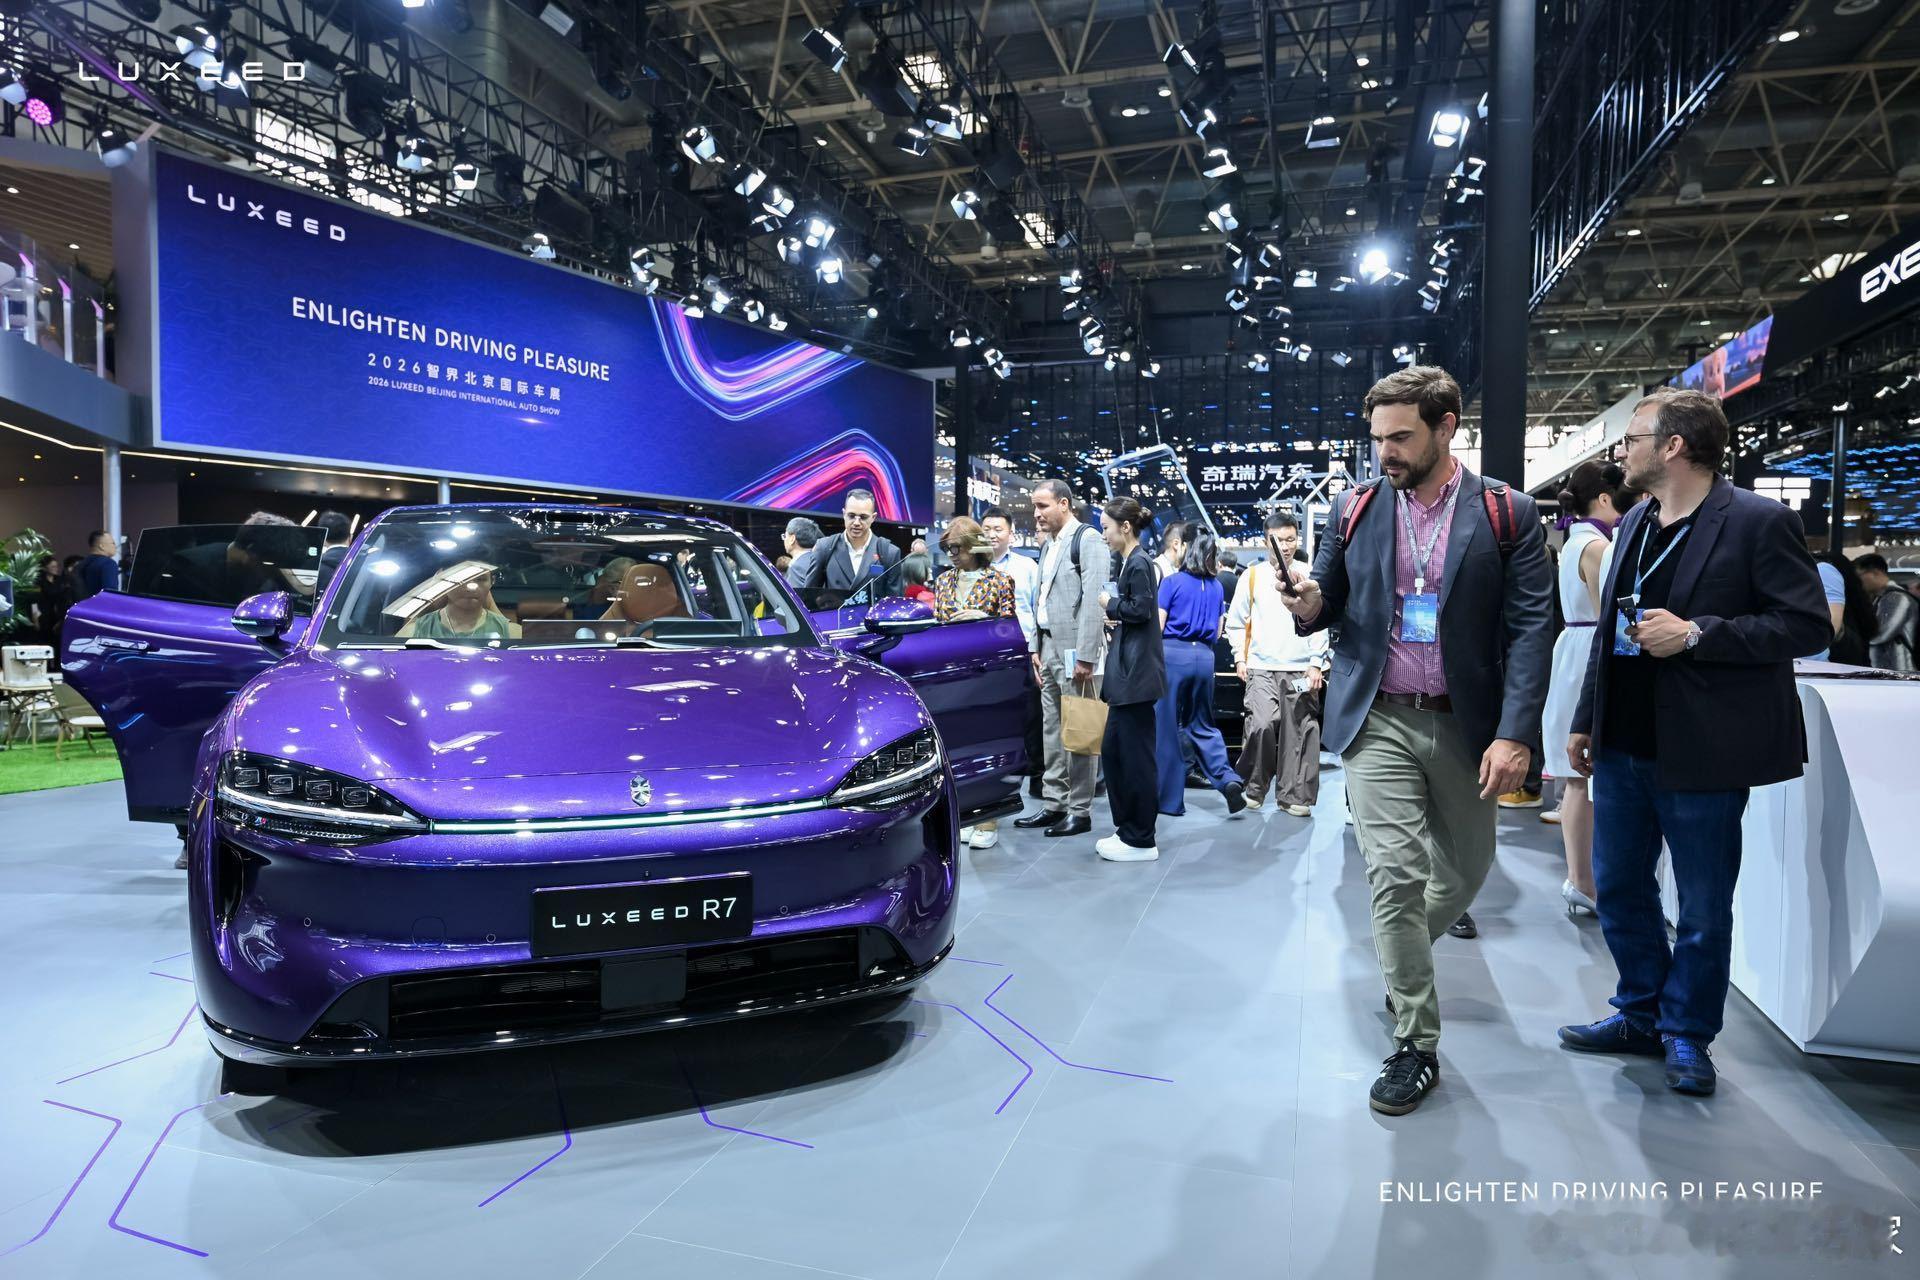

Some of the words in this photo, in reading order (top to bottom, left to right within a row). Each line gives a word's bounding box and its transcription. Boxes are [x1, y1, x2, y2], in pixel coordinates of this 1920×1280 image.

[187, 184, 346, 242] LUXEED
[292, 296, 426, 343] ENLIGHTEN
[435, 328, 517, 362] DRIVING
[523, 347, 610, 381] PLEASURE
[368, 376, 390, 388] 2026
[391, 380, 425, 393] LUXEED
[426, 385, 457, 399] BEIJING
[458, 391, 517, 409] INTERNATIONAL
[518, 402, 538, 413] AUTO
[539, 405, 561, 416] SHOW
[1200, 463, 1313, 482] 奇瑞汽车
[1200, 482, 1260, 492] CHERY
[552, 905, 689, 928] LUXEED
[702, 897, 737, 920] R7
